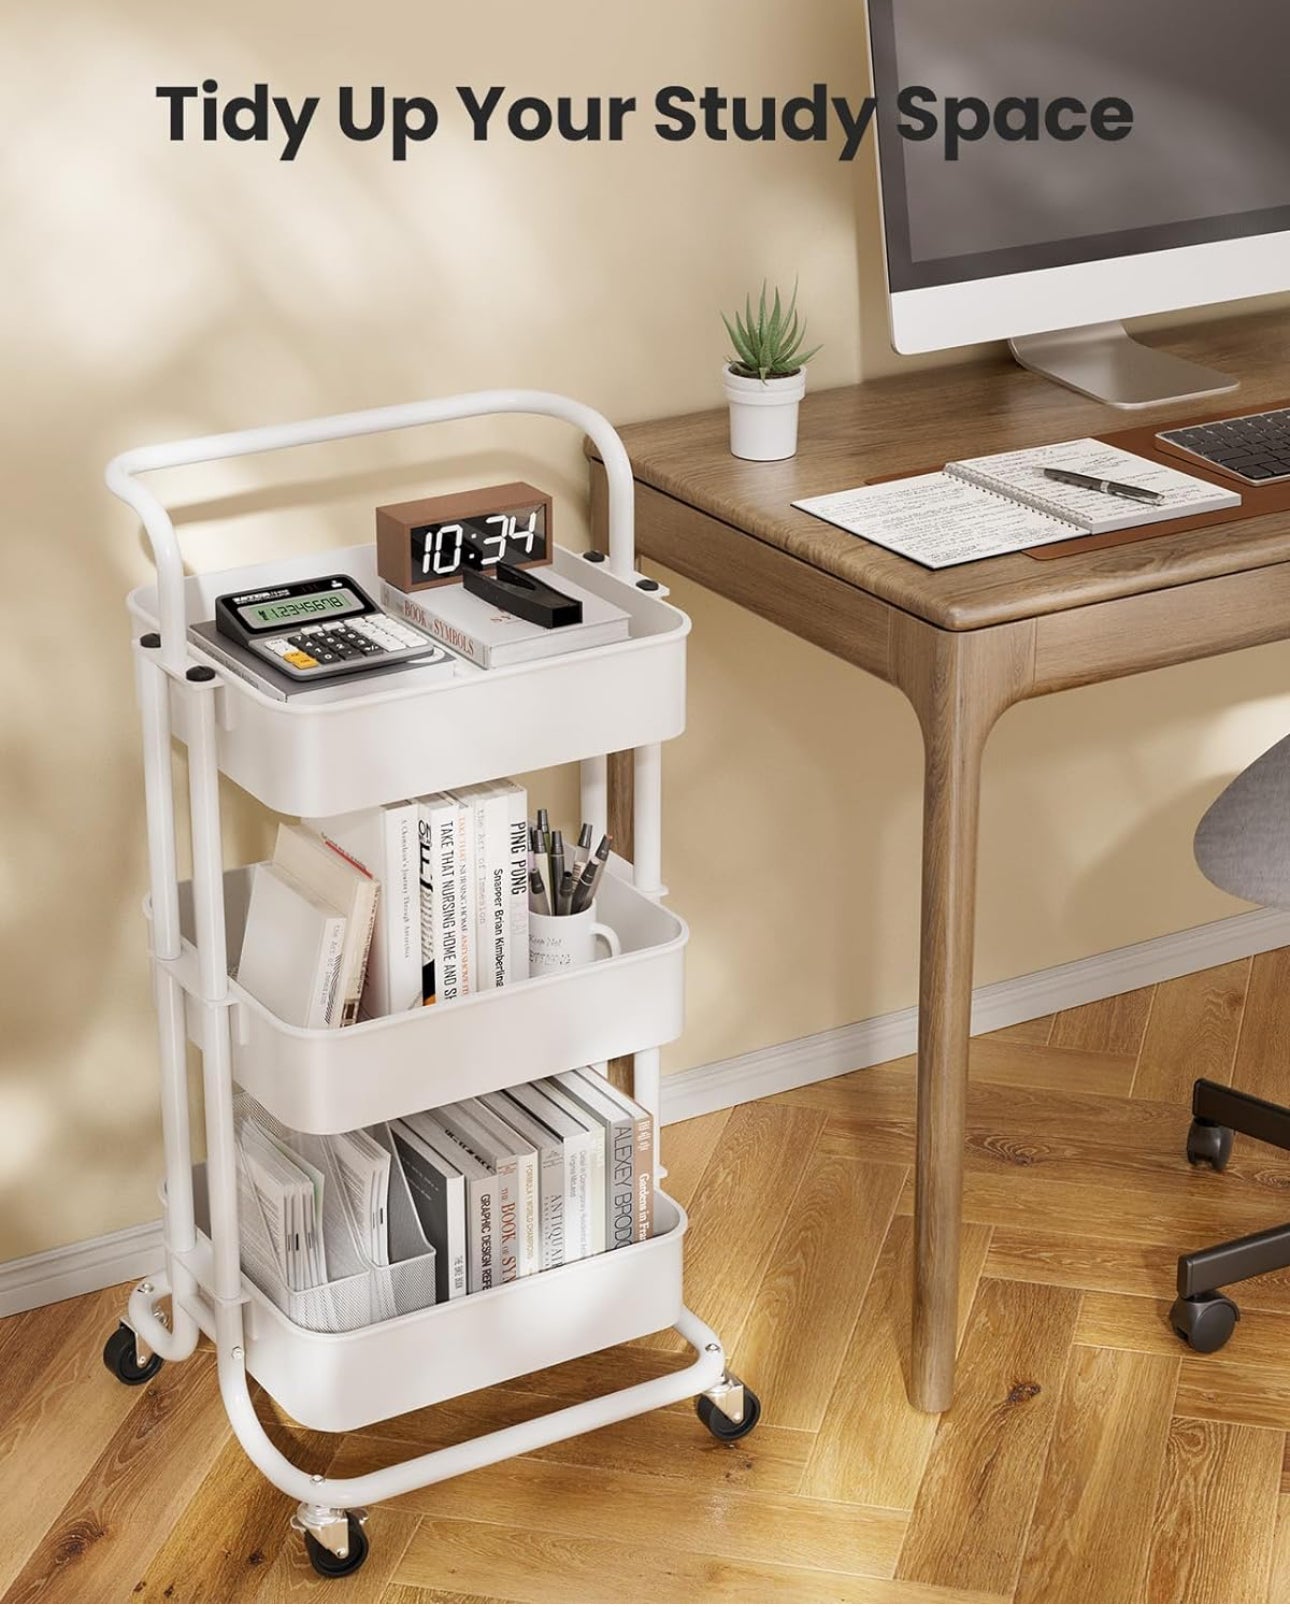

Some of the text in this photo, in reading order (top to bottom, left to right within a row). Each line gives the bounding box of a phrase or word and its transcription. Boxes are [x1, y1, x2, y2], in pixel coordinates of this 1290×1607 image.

[422, 512, 536, 574] 10:34
[404, 600, 474, 656] BOOK SYMBOLS
[441, 821, 454, 847] TAKE
[510, 821, 526, 854] PING
[442, 851, 455, 877] THAT
[511, 860, 527, 895] PONG
[442, 880, 456, 927] NURSING
[494, 868, 504, 907] Snapper
[495, 910, 504, 935] Brian
[443, 932, 456, 961] HOME
[444, 964, 457, 986] AND
[614, 1126, 632, 1188] ALEXEY
[638, 1173, 650, 1210] Gardens
[481, 1194, 492, 1233] GRAPHIC
[501, 1201, 516, 1244] BOOK
[638, 1211, 650, 1221] in
[481, 1235, 492, 1266] DESIGN
